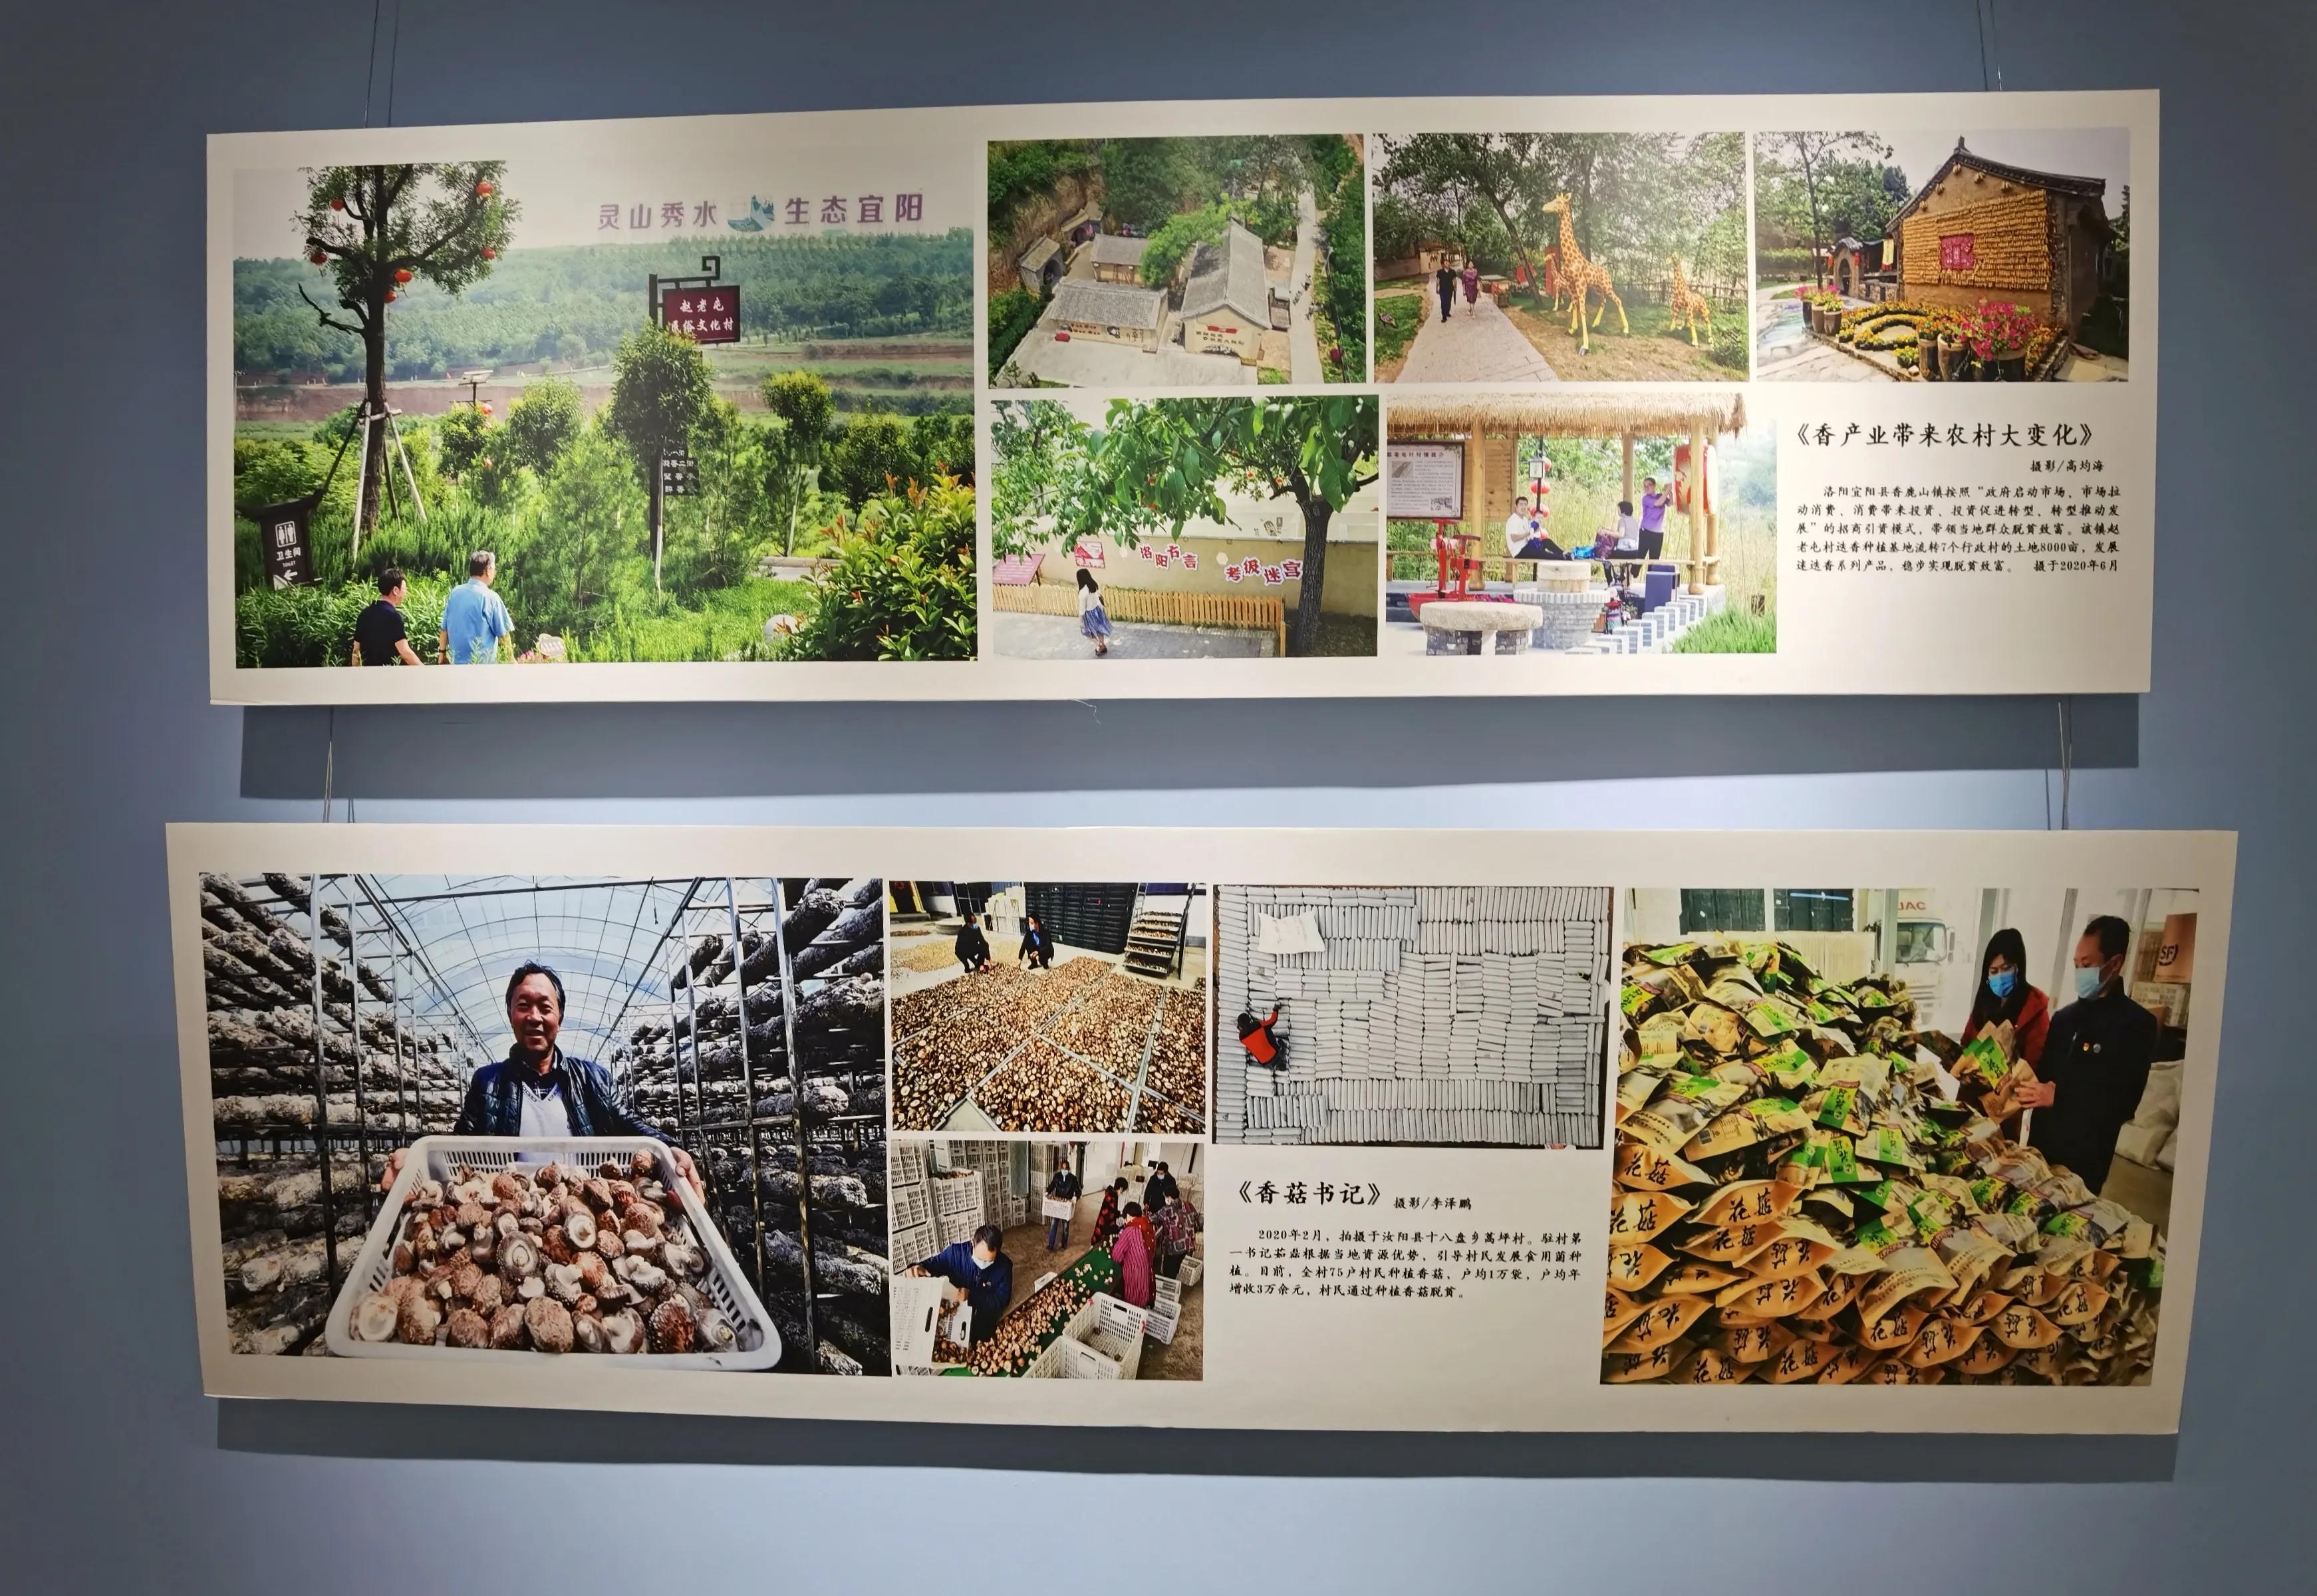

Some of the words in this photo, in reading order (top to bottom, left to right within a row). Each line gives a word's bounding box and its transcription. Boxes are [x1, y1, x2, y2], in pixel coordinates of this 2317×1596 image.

[598, 201, 717, 231] 灵山秀水
[785, 194, 922, 223] 生态宜阳
[680, 297, 724, 313] 赵老屯
[672, 317, 734, 334] 民俗文化村
[1797, 423, 2093, 447] 《香产业带来农村大变化》
[2030, 459, 2104, 473] 摄影/高均海
[276, 547, 301, 561] 卫生间
[1139, 543, 1198, 570] 洛阳方言
[1226, 558, 1301, 584] 考级迷宫
[1897, 901, 1926, 910] JAC
[2160, 944, 2175, 960] SF
[1623, 1152, 1671, 1186] 花菇
[1238, 1180, 1381, 1206] 《香菇书记》
[1729, 1186, 1773, 1222] 花菇
[1609, 1199, 1657, 1234] 花菇
[1712, 1224, 1758, 1252] 花菇
